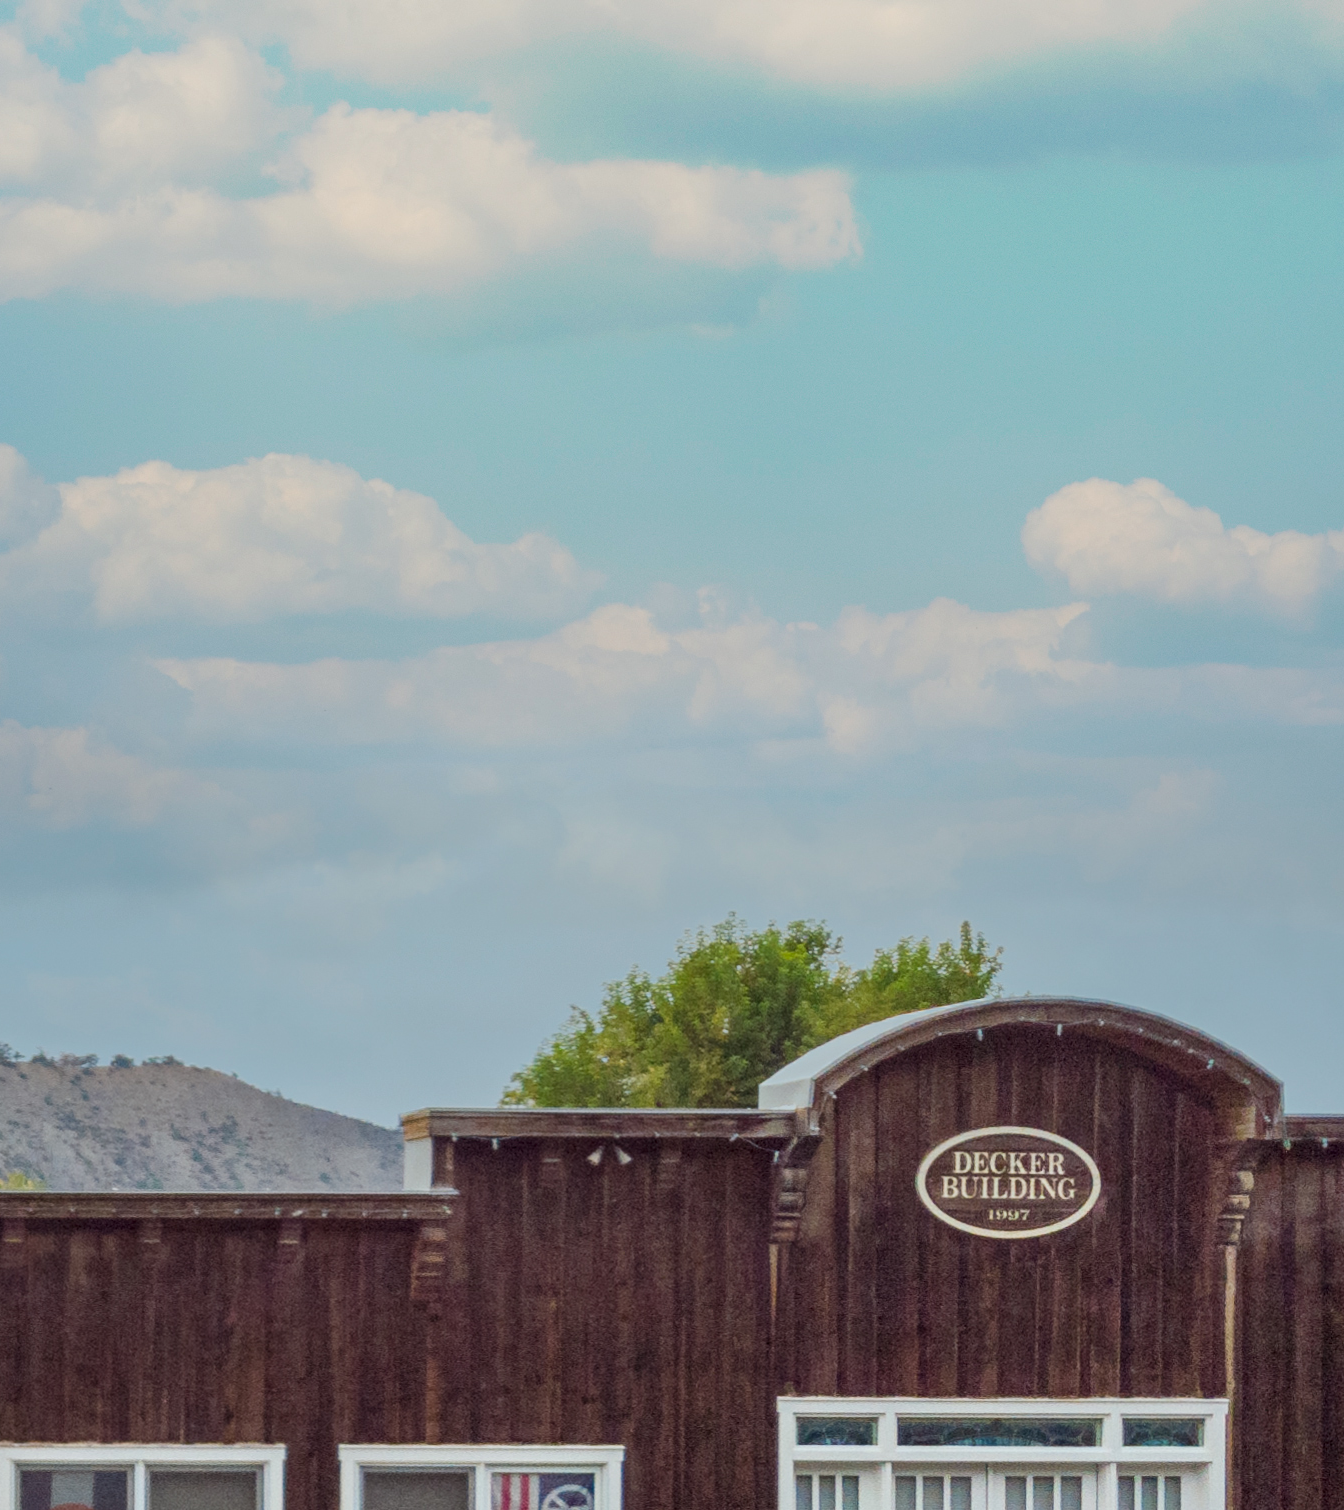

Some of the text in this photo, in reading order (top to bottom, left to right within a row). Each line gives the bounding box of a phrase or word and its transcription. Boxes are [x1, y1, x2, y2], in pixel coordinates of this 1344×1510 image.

[953, 1151, 1065, 1175] DECKER
[941, 1175, 1077, 1200] BUILDING
[988, 1209, 1030, 1221] 1997
